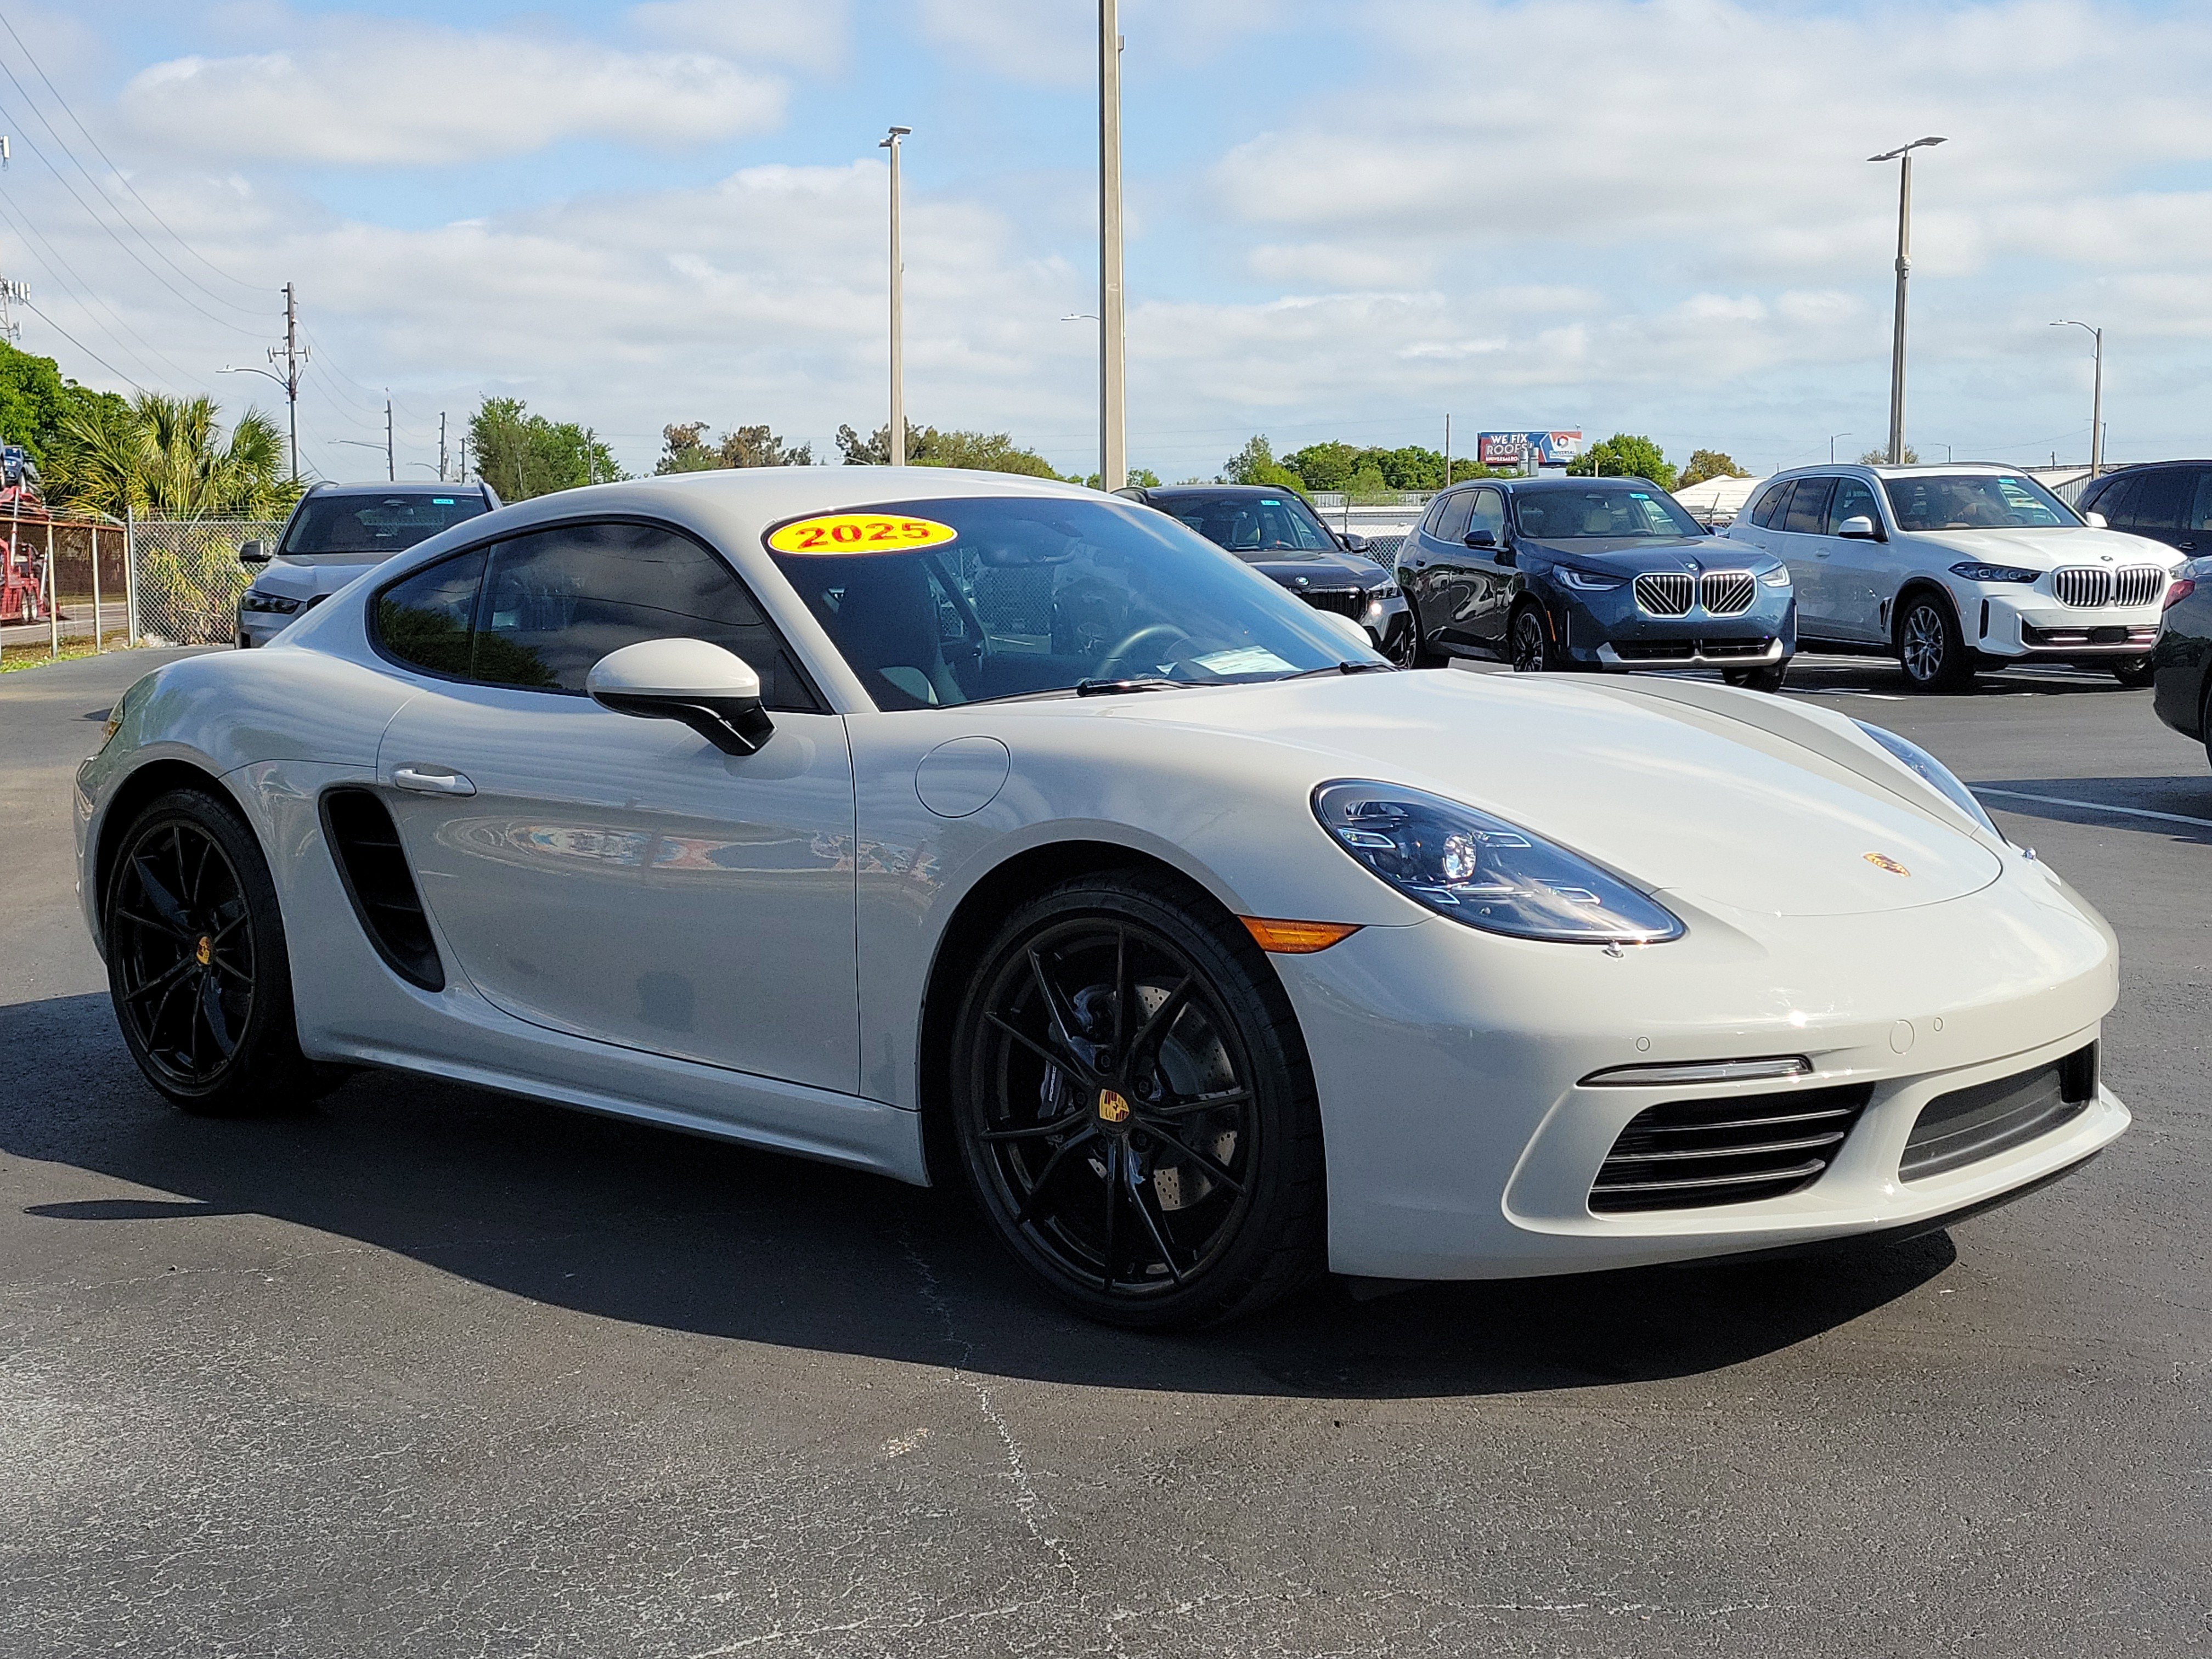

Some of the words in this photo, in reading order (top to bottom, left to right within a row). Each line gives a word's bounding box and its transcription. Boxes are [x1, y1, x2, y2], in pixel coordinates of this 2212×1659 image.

[1491, 435, 1508, 444] WE
[1511, 433, 1528, 443] FIX
[795, 523, 930, 549] 2025
[1048, 1065, 1057, 1102] PORSC
